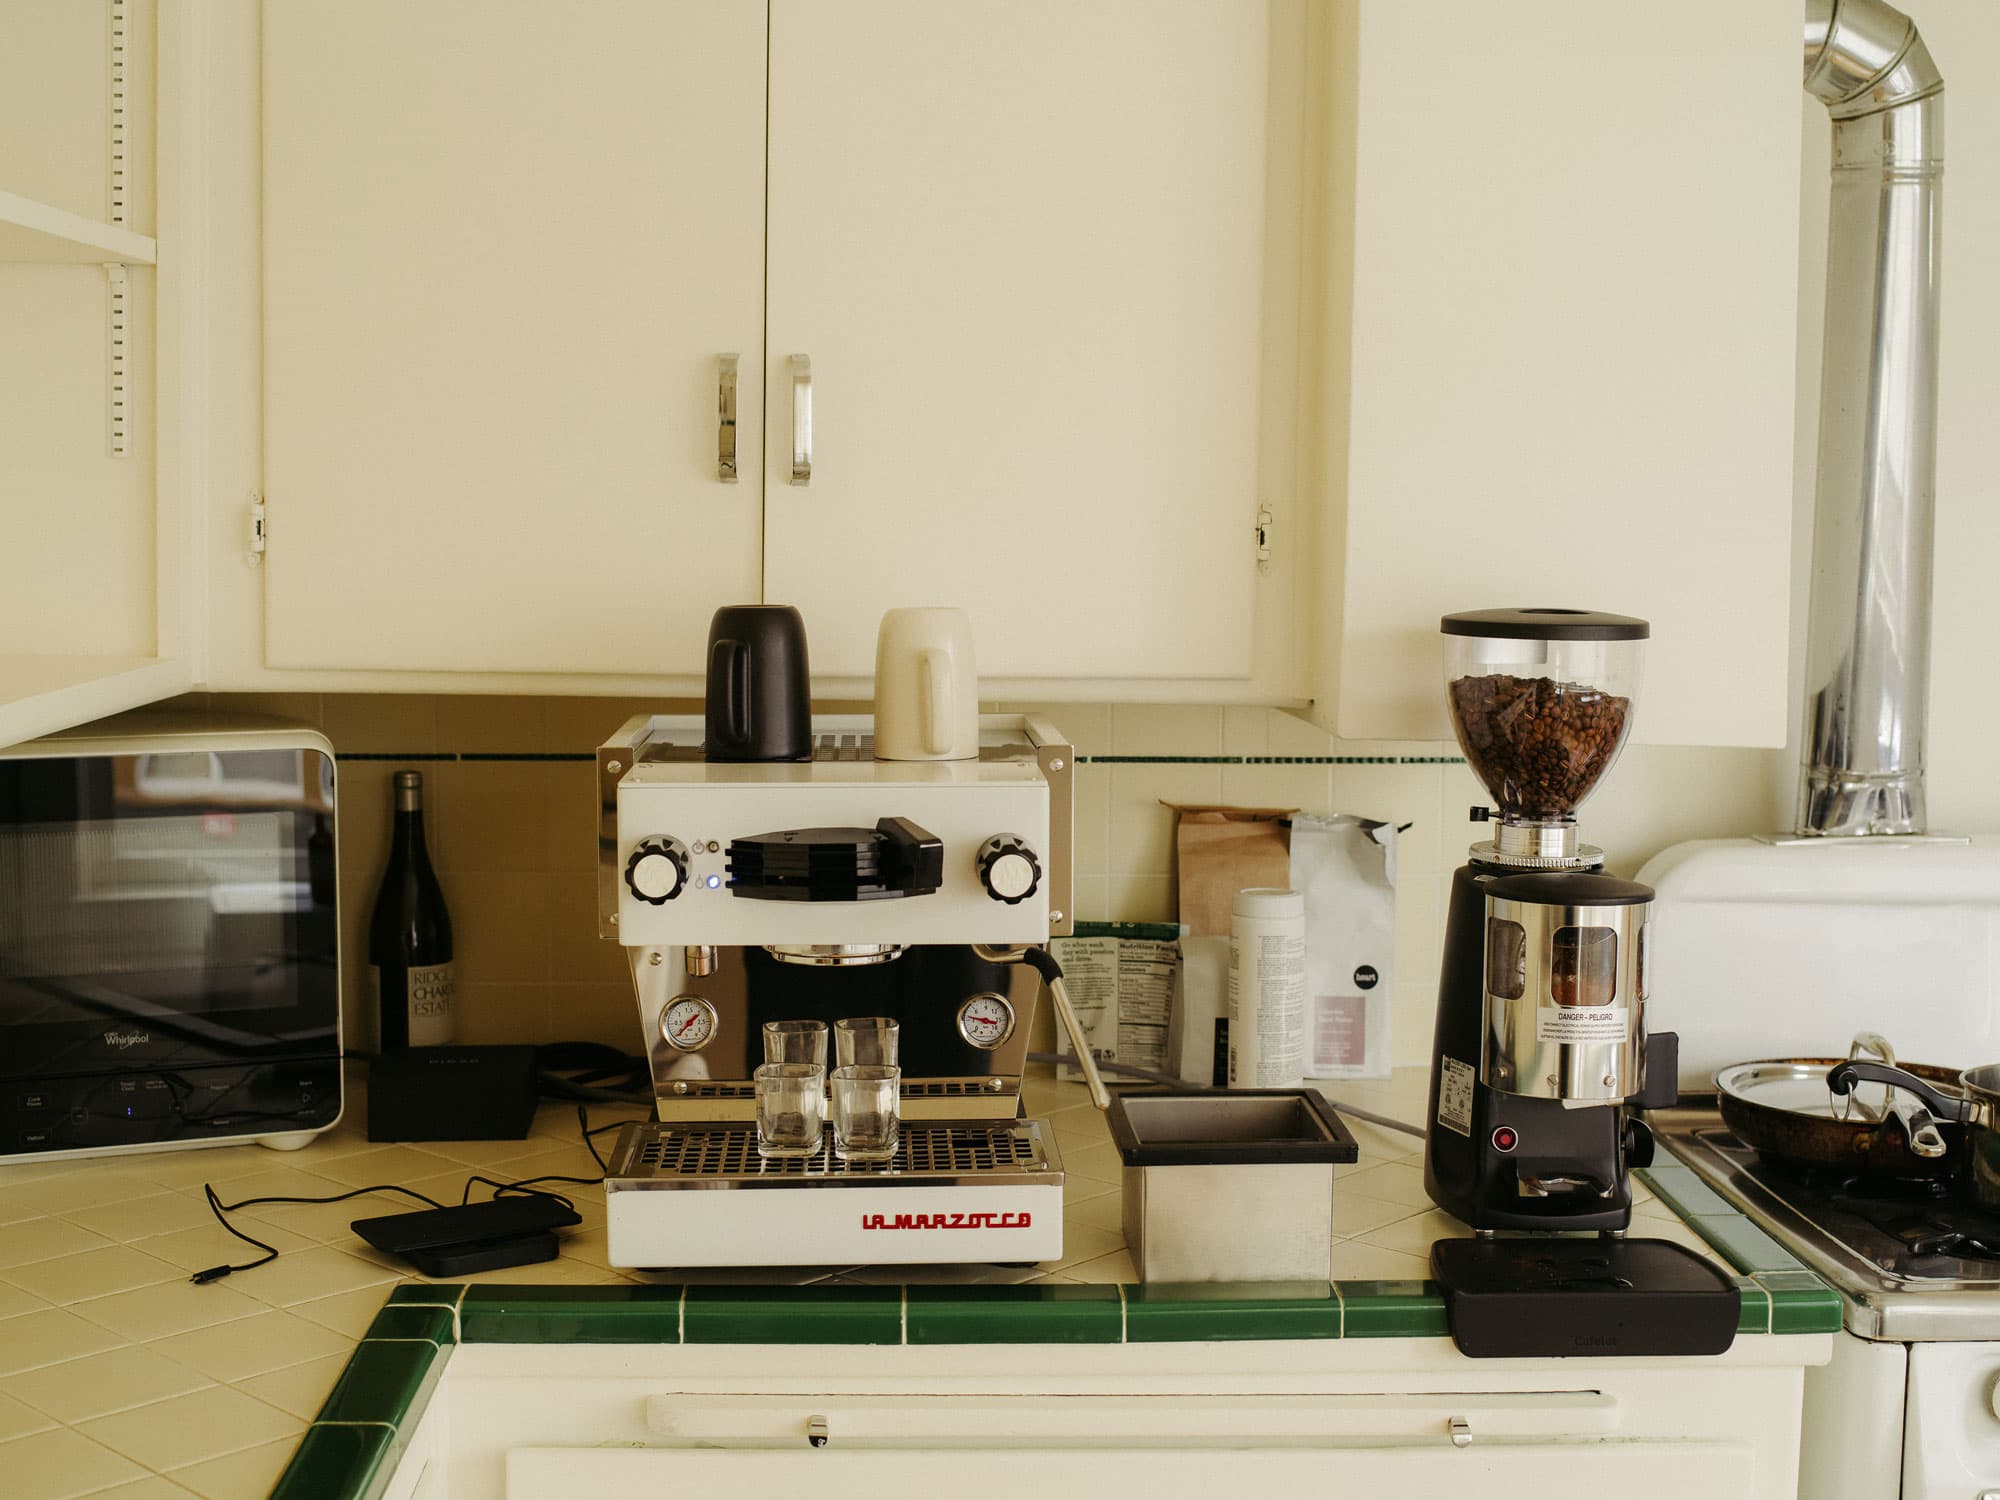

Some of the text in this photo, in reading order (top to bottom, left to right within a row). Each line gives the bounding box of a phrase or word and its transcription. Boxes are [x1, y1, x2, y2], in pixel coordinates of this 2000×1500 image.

[413, 984, 454, 1001] CHAR
[1558, 1012, 1584, 1021] DANGER
[1588, 1013, 1613, 1021] PELIGRO
[104, 1031, 149, 1050] Whirlpool
